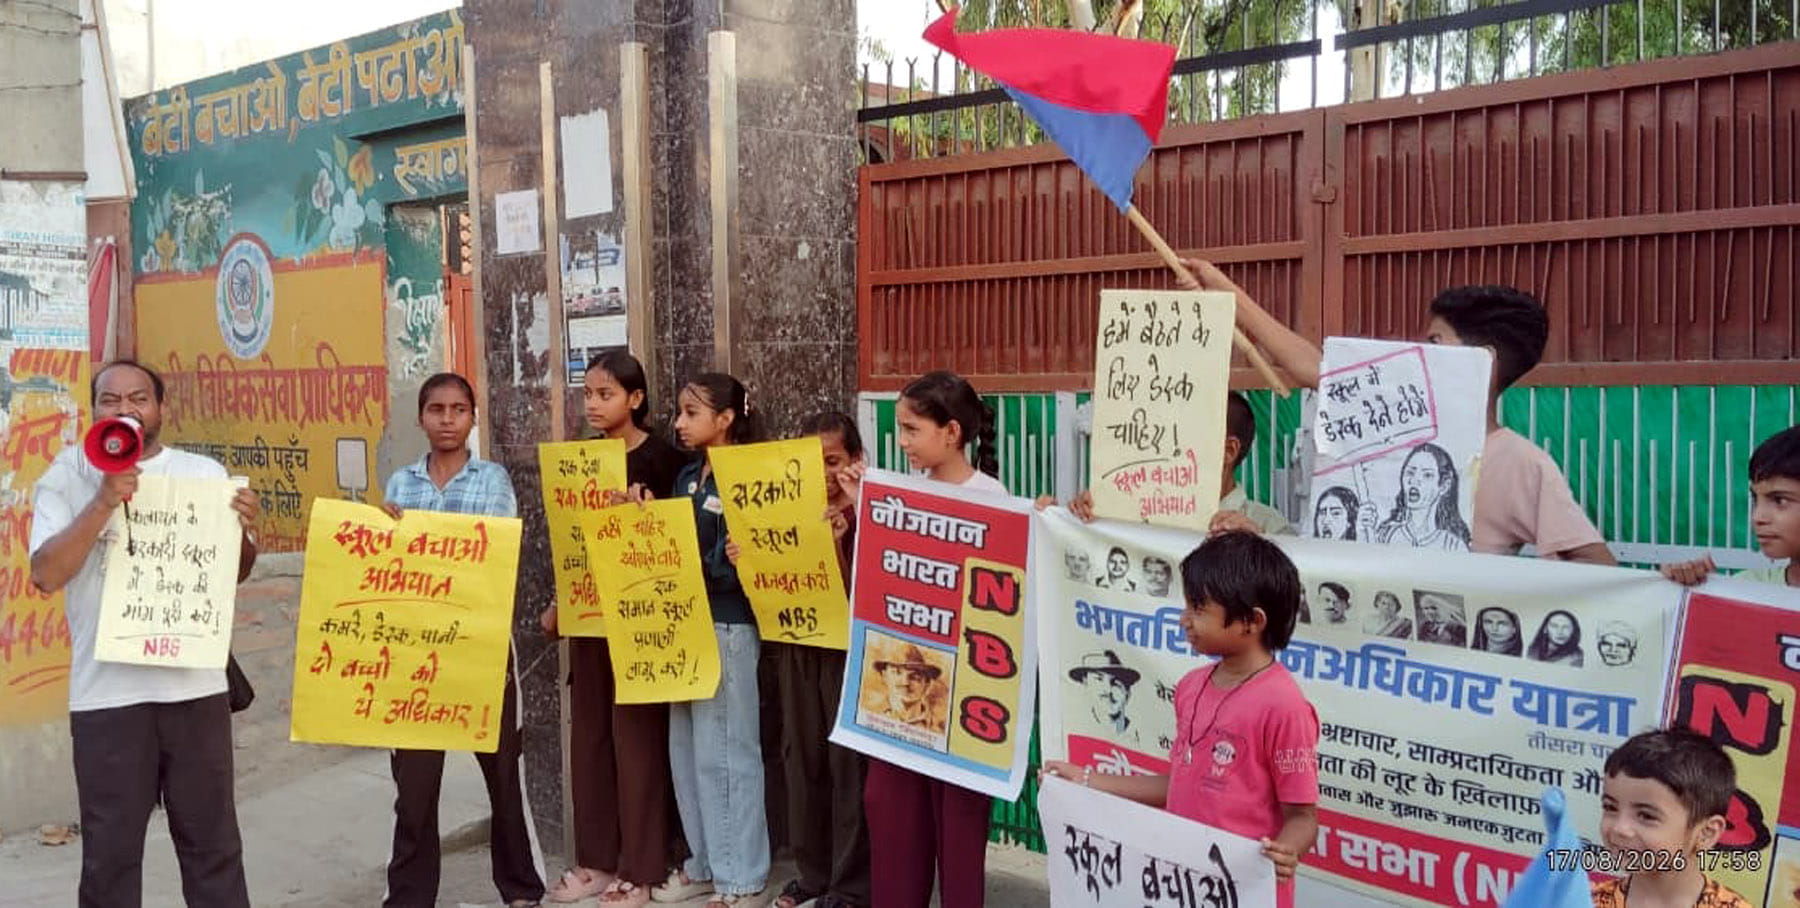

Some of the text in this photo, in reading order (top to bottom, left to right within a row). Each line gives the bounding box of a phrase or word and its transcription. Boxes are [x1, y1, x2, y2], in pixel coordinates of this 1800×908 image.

[141, 84, 190, 158] बेटी
[297, 46, 353, 122] बेटी
[394, 138, 467, 196] स्वाग
[1104, 300, 1210, 349] हमें बैठने के
[298, 341, 389, 430] प्राधिकरण
[1147, 352, 1194, 403] डेस्क
[1326, 364, 1381, 404] स्कूल में
[1319, 410, 1363, 442] डेस्क
[1362, 393, 1393, 433] देने
[231, 435, 270, 468] आपकी
[272, 433, 309, 483] पहुँच
[558, 459, 578, 478] एक
[1113, 447, 1198, 495] स्कूल बचाओ
[260, 478, 273, 515] के
[554, 487, 577, 511] एक
[729, 458, 803, 509] सरकारी
[1140, 487, 1196, 518] अभियान
[186, 500, 199, 526] के
[869, 494, 988, 549] नौजवान
[182, 542, 217, 569] स्कूल
[333, 520, 394, 560] स्कूल
[407, 520, 490, 564] बचाओ
[750, 525, 800, 555] स्कूल
[126, 565, 145, 591] में
[192, 571, 208, 594] की
[358, 556, 453, 598] अभियान
[654, 580, 678, 597] एक
[754, 560, 830, 595] मजबूत करो
[881, 547, 960, 590] भारत
[162, 597, 182, 628] पूरी
[618, 595, 696, 622] समान स्कूल
[777, 606, 819, 633] NBS
[884, 593, 955, 637] सभा
[143, 637, 182, 658] NBS
[410, 650, 440, 685] को
[625, 660, 656, 683] लागू
[353, 681, 375, 718] ये
[1509, 678, 1637, 738] यात्रा
[1321, 721, 1401, 760] भ्रष्टाचार,
[1406, 740, 1565, 788] साम्प्रदायिकता
[1526, 730, 1585, 756] तीसरा
[1348, 757, 1377, 784] की
[1381, 766, 1418, 797] लूट
[1423, 772, 1447, 797] के
[1356, 789, 1385, 811] और
[1387, 798, 1439, 822] जुझारू
[1063, 822, 1240, 908] स्कूल बचाओ
[1336, 828, 1441, 889] सभा
